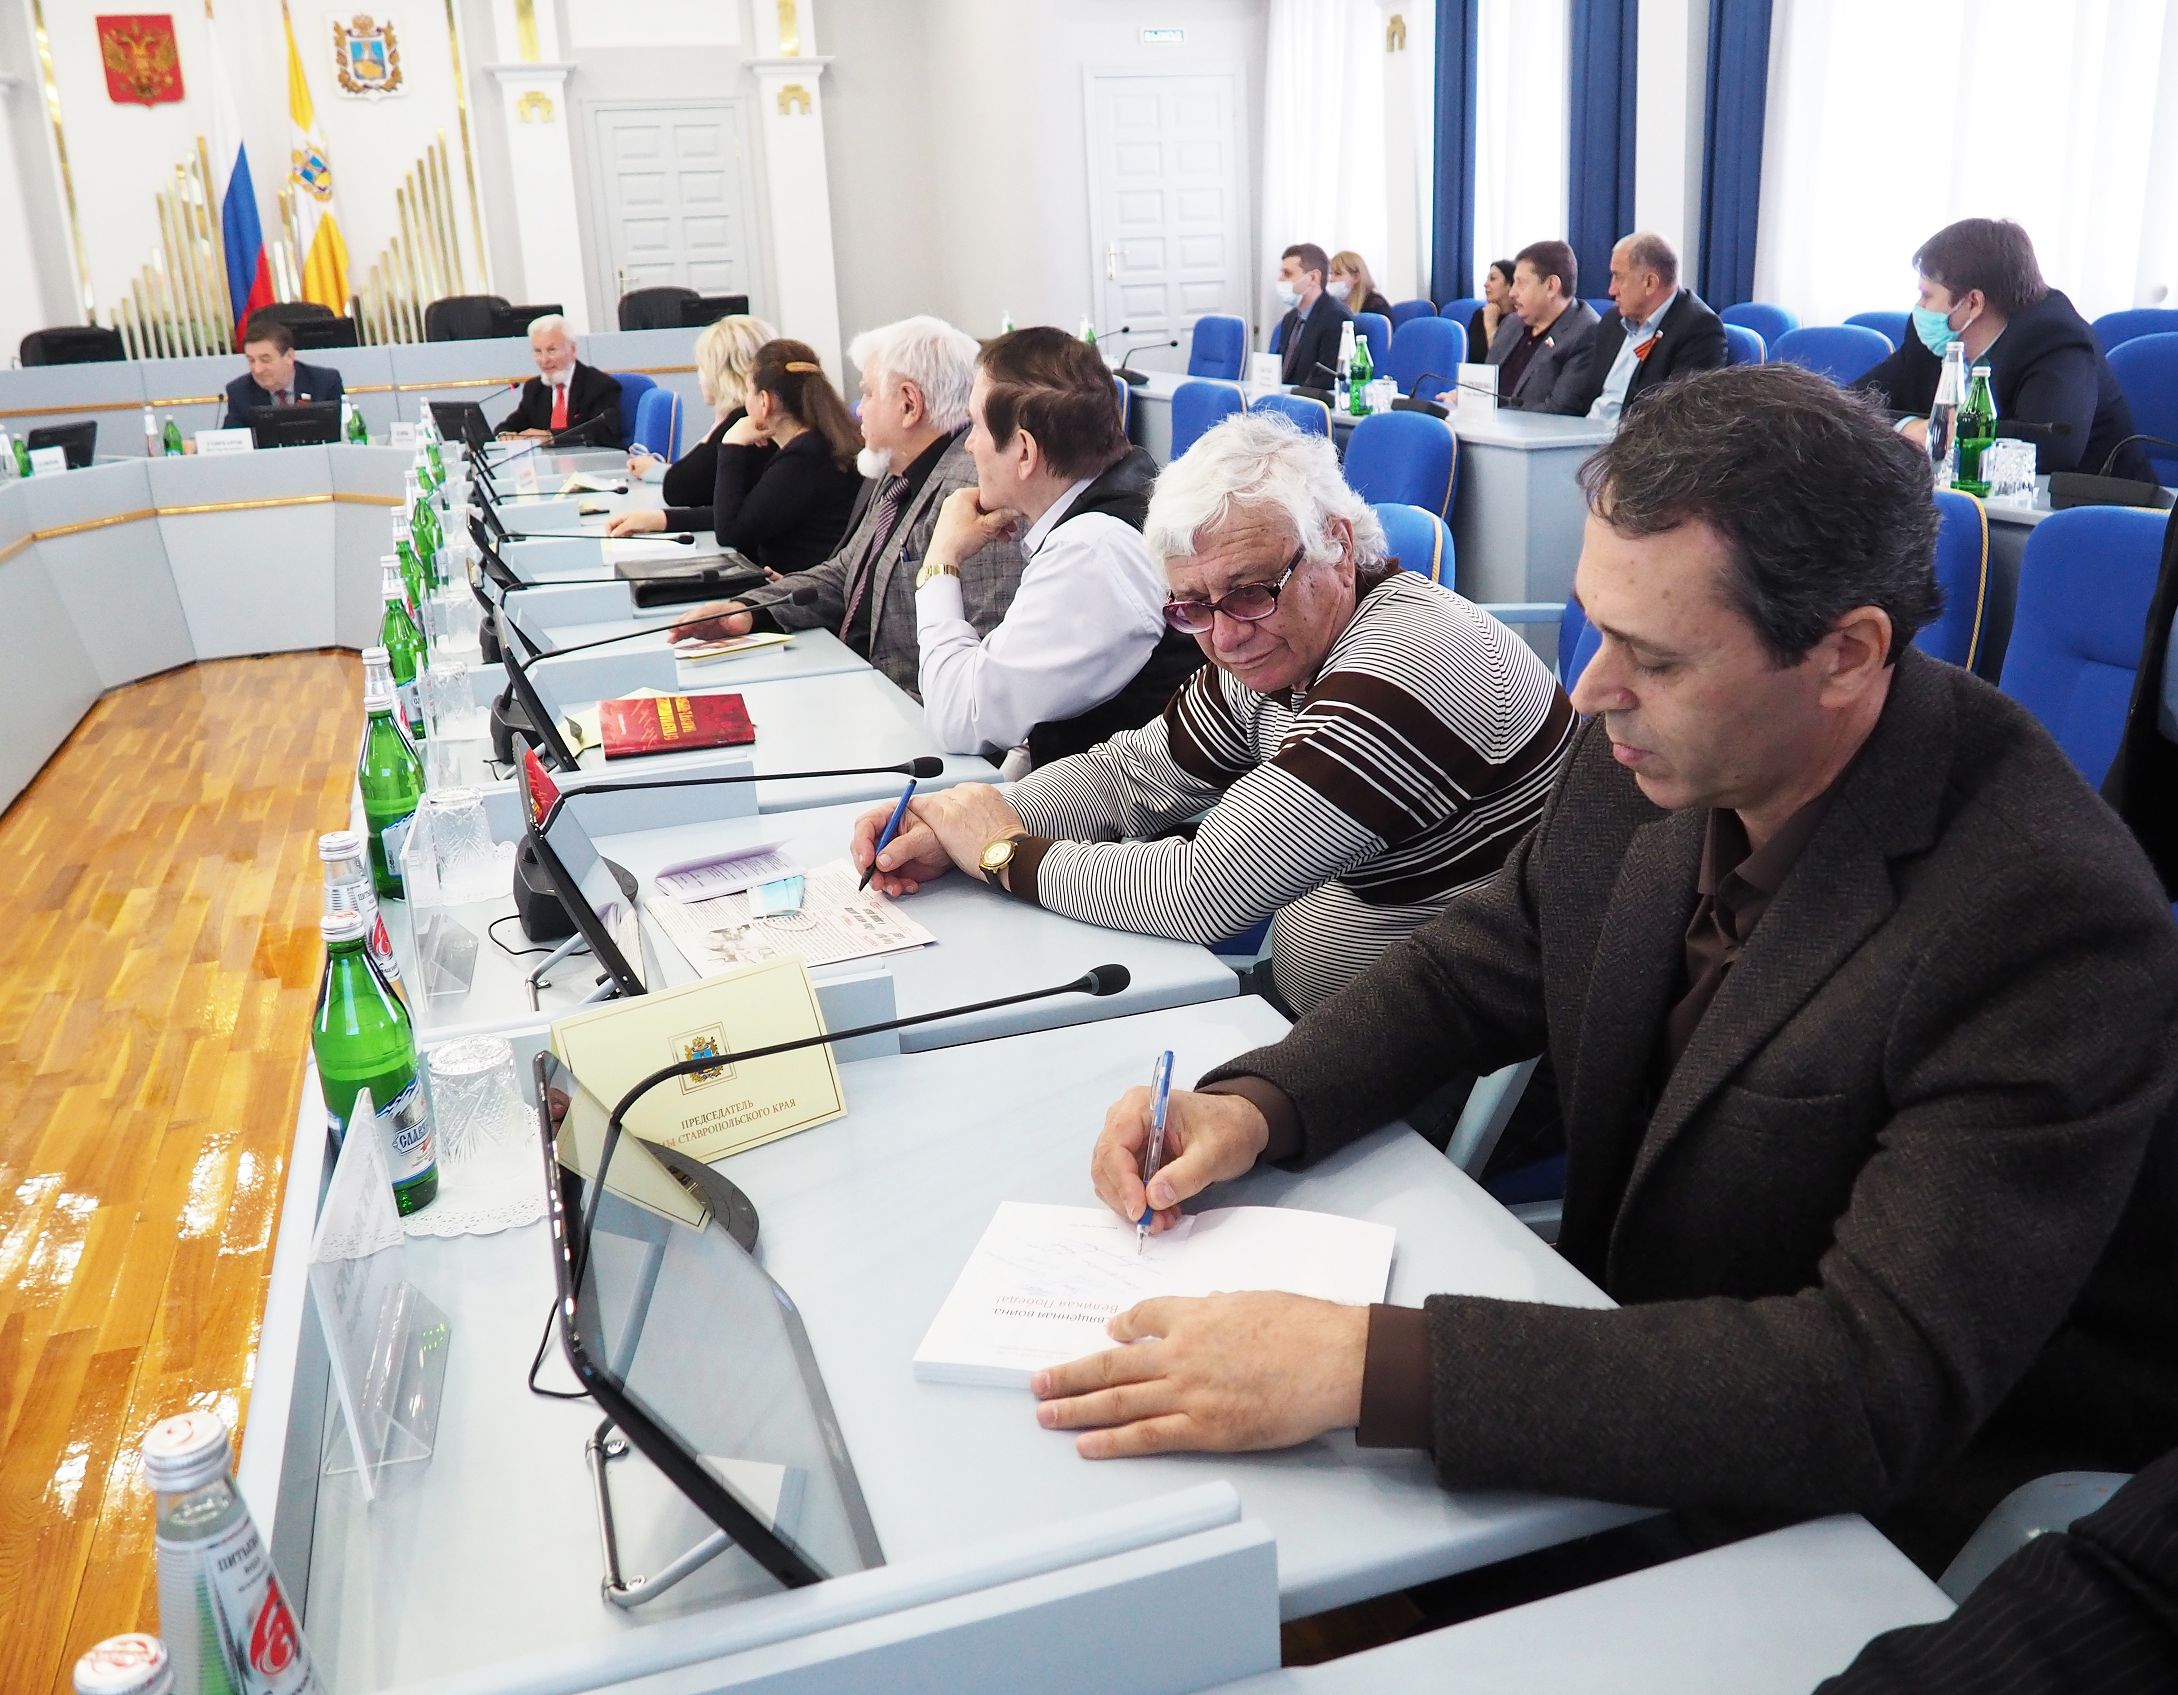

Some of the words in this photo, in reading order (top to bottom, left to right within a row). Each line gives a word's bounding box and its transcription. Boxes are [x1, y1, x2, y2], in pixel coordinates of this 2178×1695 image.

[678, 1107, 770, 1144] СТАВРОПОЛЬСКОГО
[772, 1098, 796, 1113] КРАЯ
[681, 1099, 754, 1130] ПРЕДСЕДАТЕЛЬ
[1038, 1312, 1106, 1325] вященная
